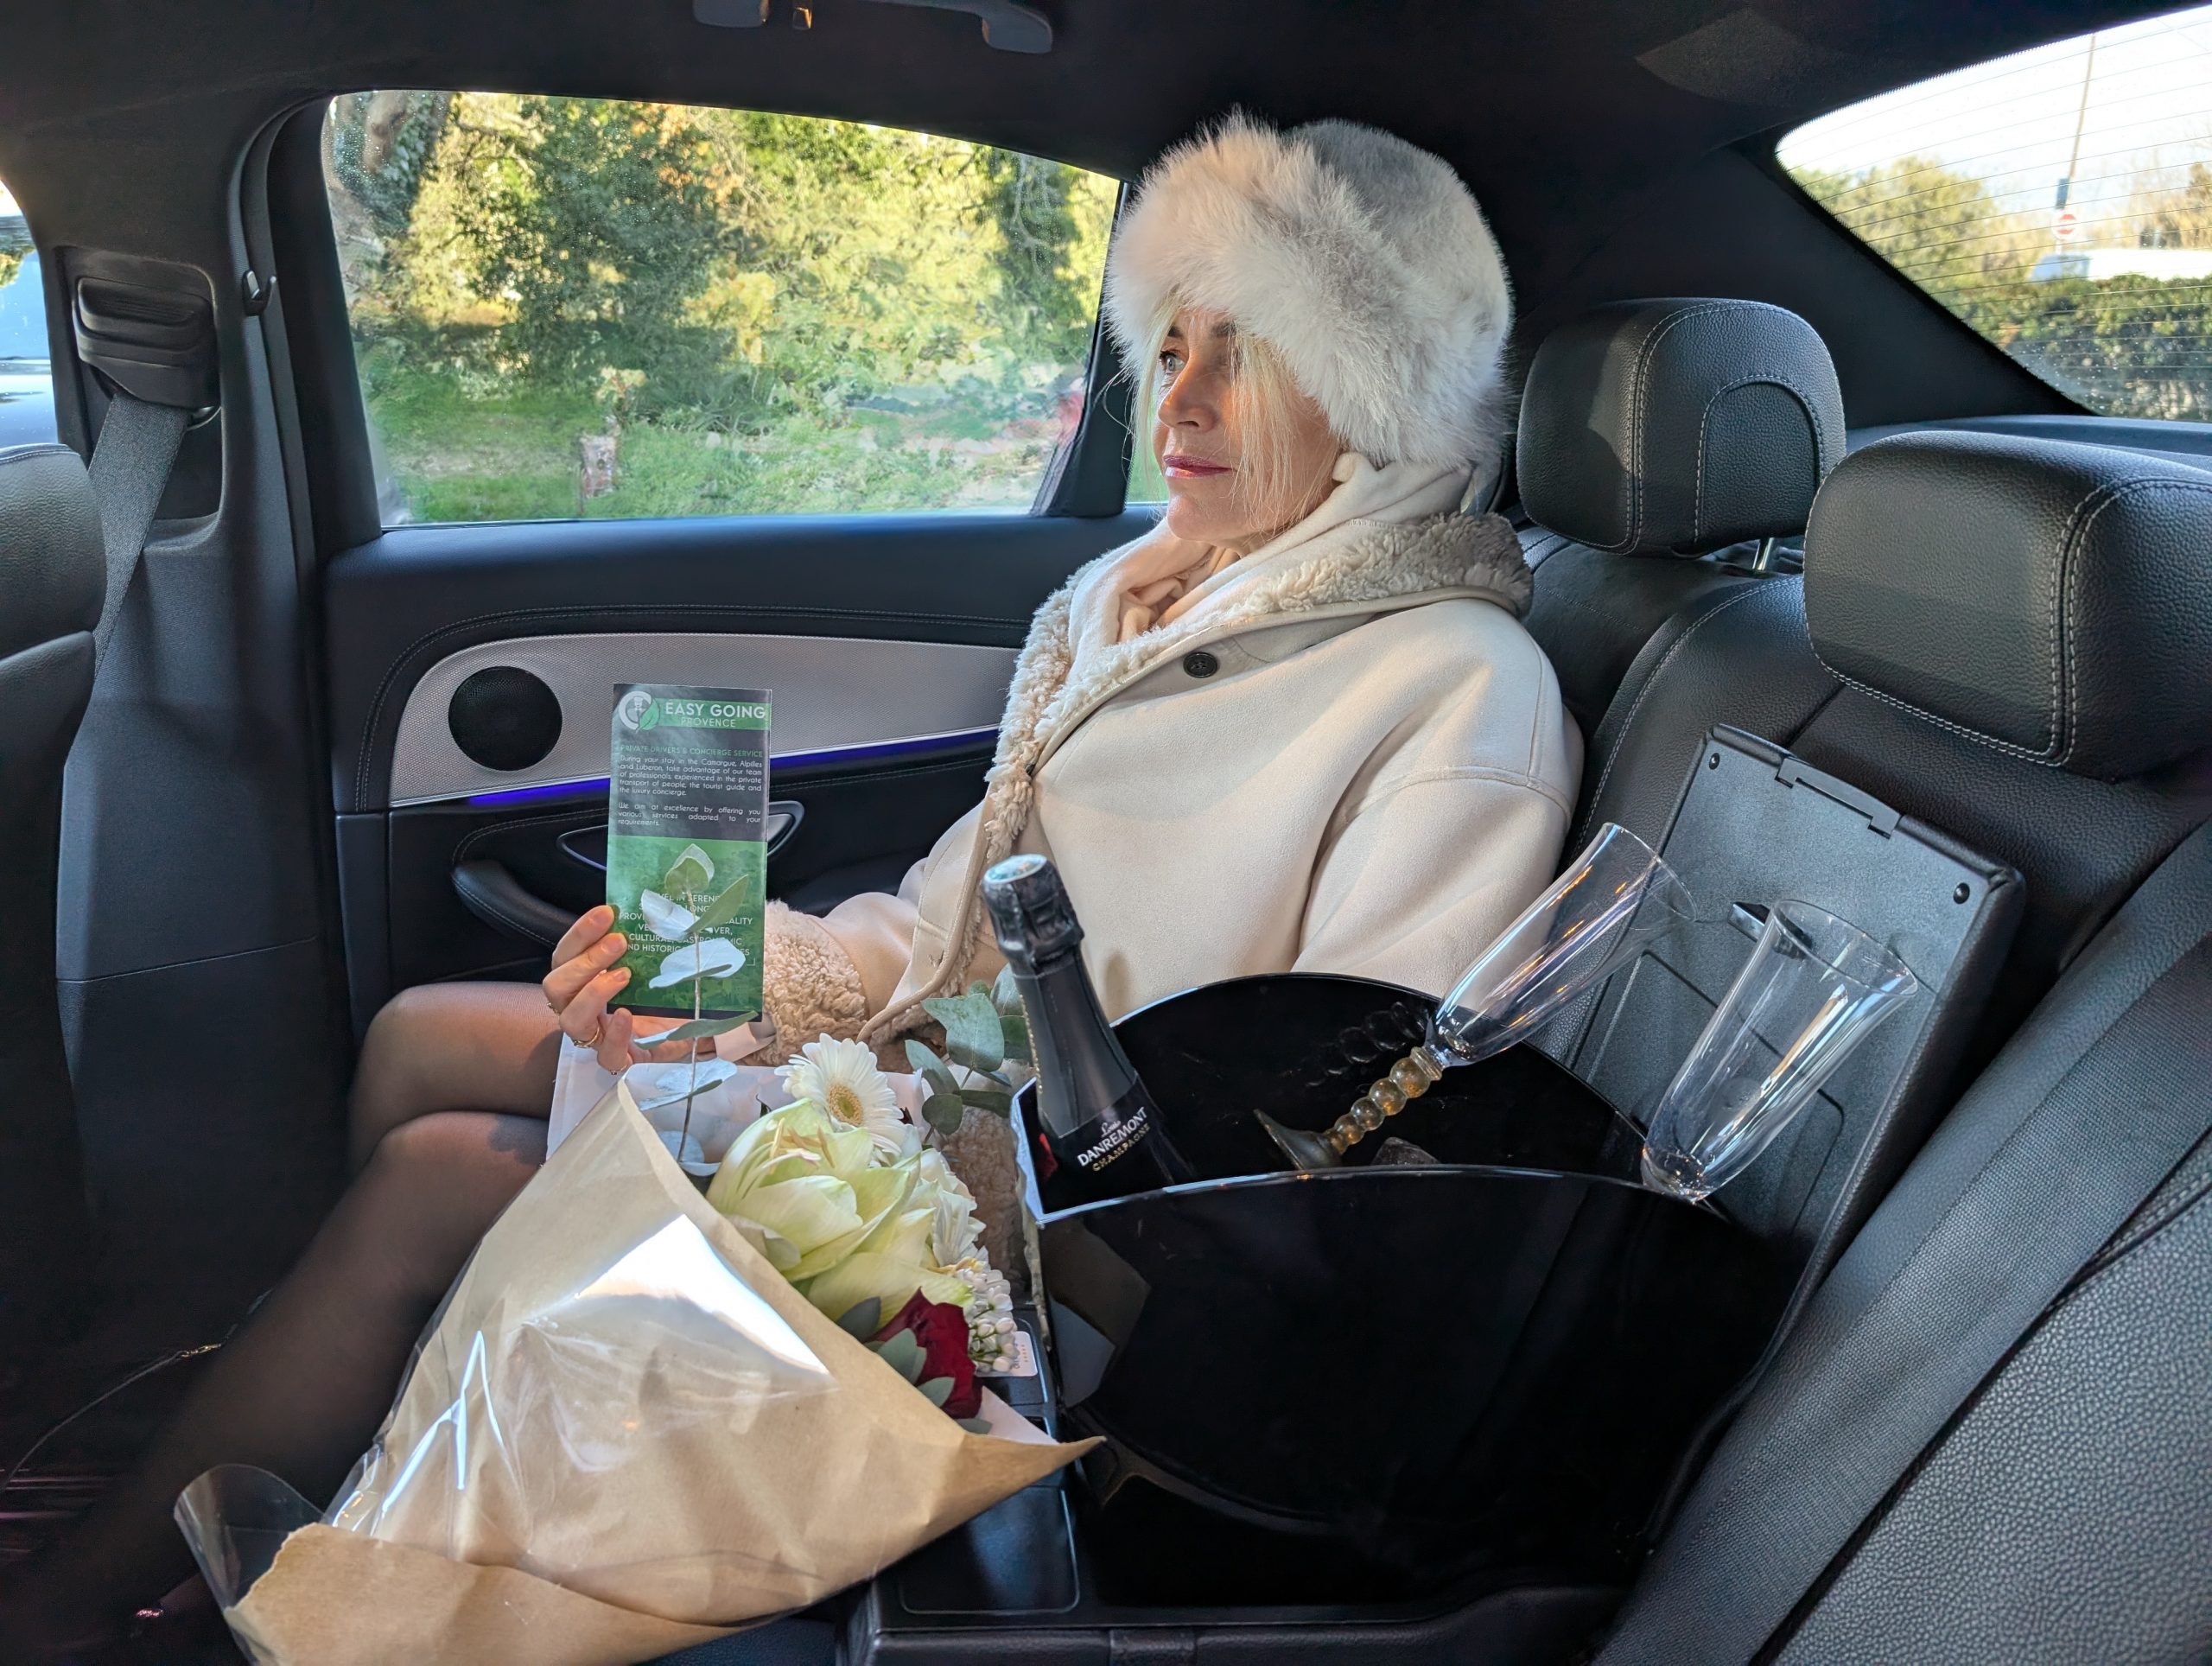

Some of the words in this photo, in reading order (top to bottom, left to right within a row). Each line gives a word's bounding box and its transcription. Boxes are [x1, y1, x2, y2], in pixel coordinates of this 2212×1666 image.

[665, 703, 704, 715] EASY
[710, 704, 766, 719] GOING
[681, 717, 736, 728] PROVENCE
[620, 755, 641, 764] During
[718, 806, 743, 815] offering
[1077, 1106, 1147, 1167] DANREMONT
[1092, 1122, 1150, 1172] CHAMPAGNE
